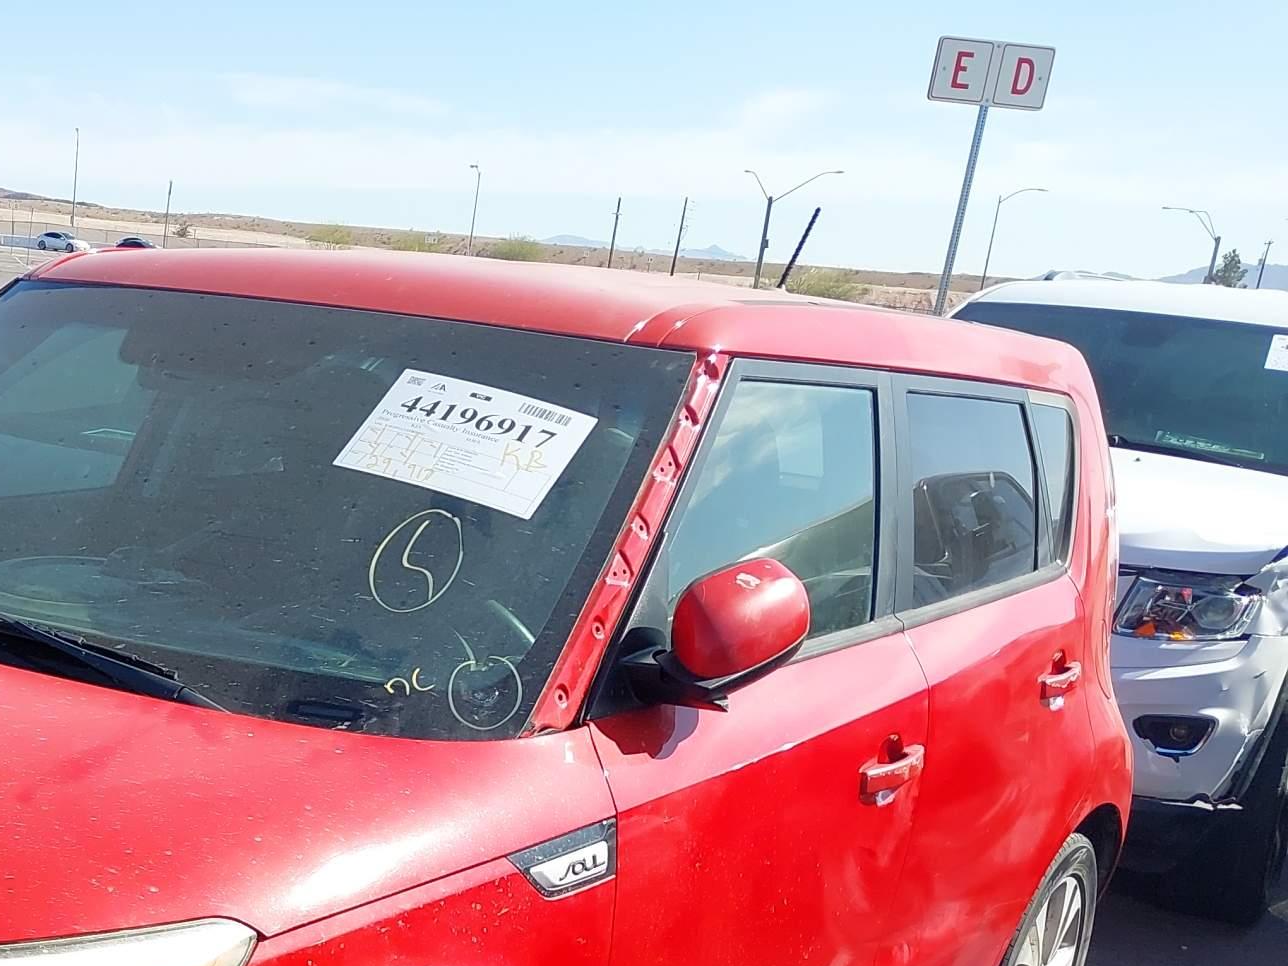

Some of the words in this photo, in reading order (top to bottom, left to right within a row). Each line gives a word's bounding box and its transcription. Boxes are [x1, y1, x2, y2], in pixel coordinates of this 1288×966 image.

[950, 51, 974, 89] E
[1011, 57, 1035, 95] D
[381, 408, 426, 424] Progressive
[426, 419, 458, 433] Casualty
[461, 427, 500, 443] Insurance
[401, 395, 558, 448] 44196917
